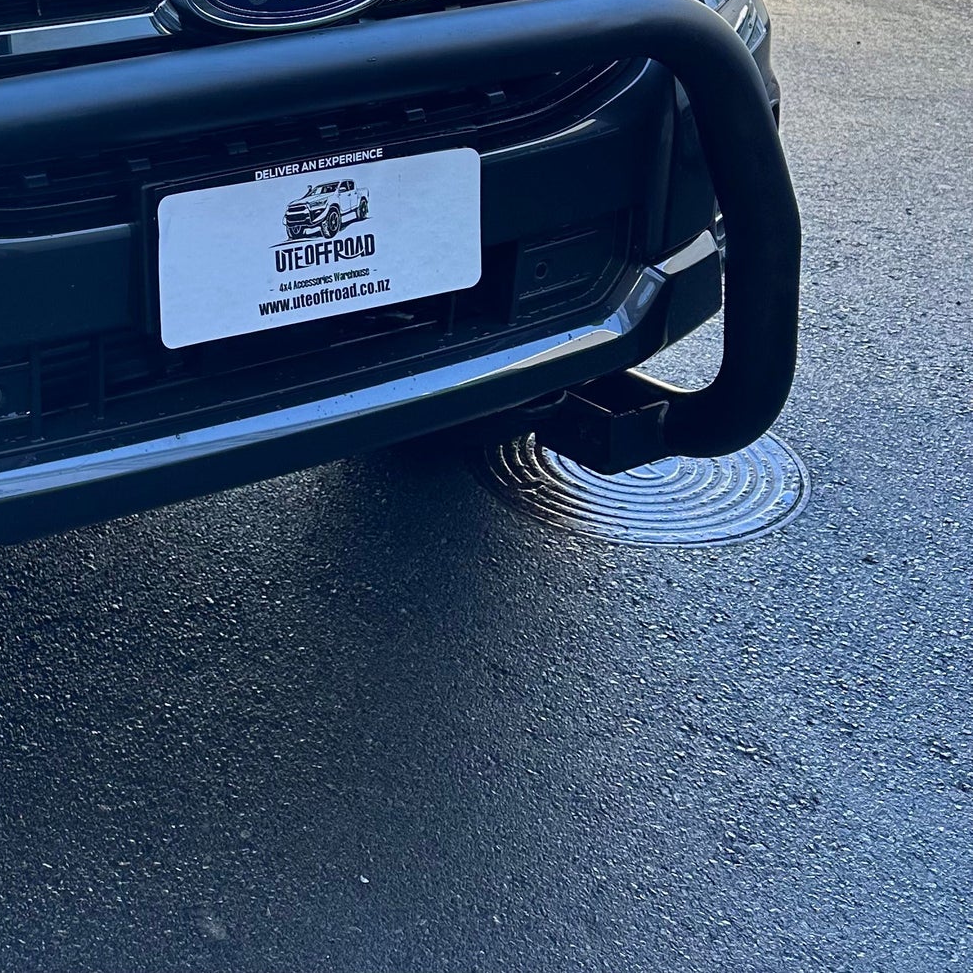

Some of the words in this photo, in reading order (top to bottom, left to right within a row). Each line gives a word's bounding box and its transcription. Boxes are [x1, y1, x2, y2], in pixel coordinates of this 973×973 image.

[255, 165, 300, 181] DELIVER
[301, 160, 317, 173] AN
[318, 148, 383, 169] EXPERIENCE
[275, 233, 376, 273] UTEOFFROAD
[259, 278, 391, 316] www.uteoffroad.co.nz
[279, 281, 293, 293] 4x4
[293, 274, 333, 290] Accessories
[333, 267, 370, 282] Warehouse
